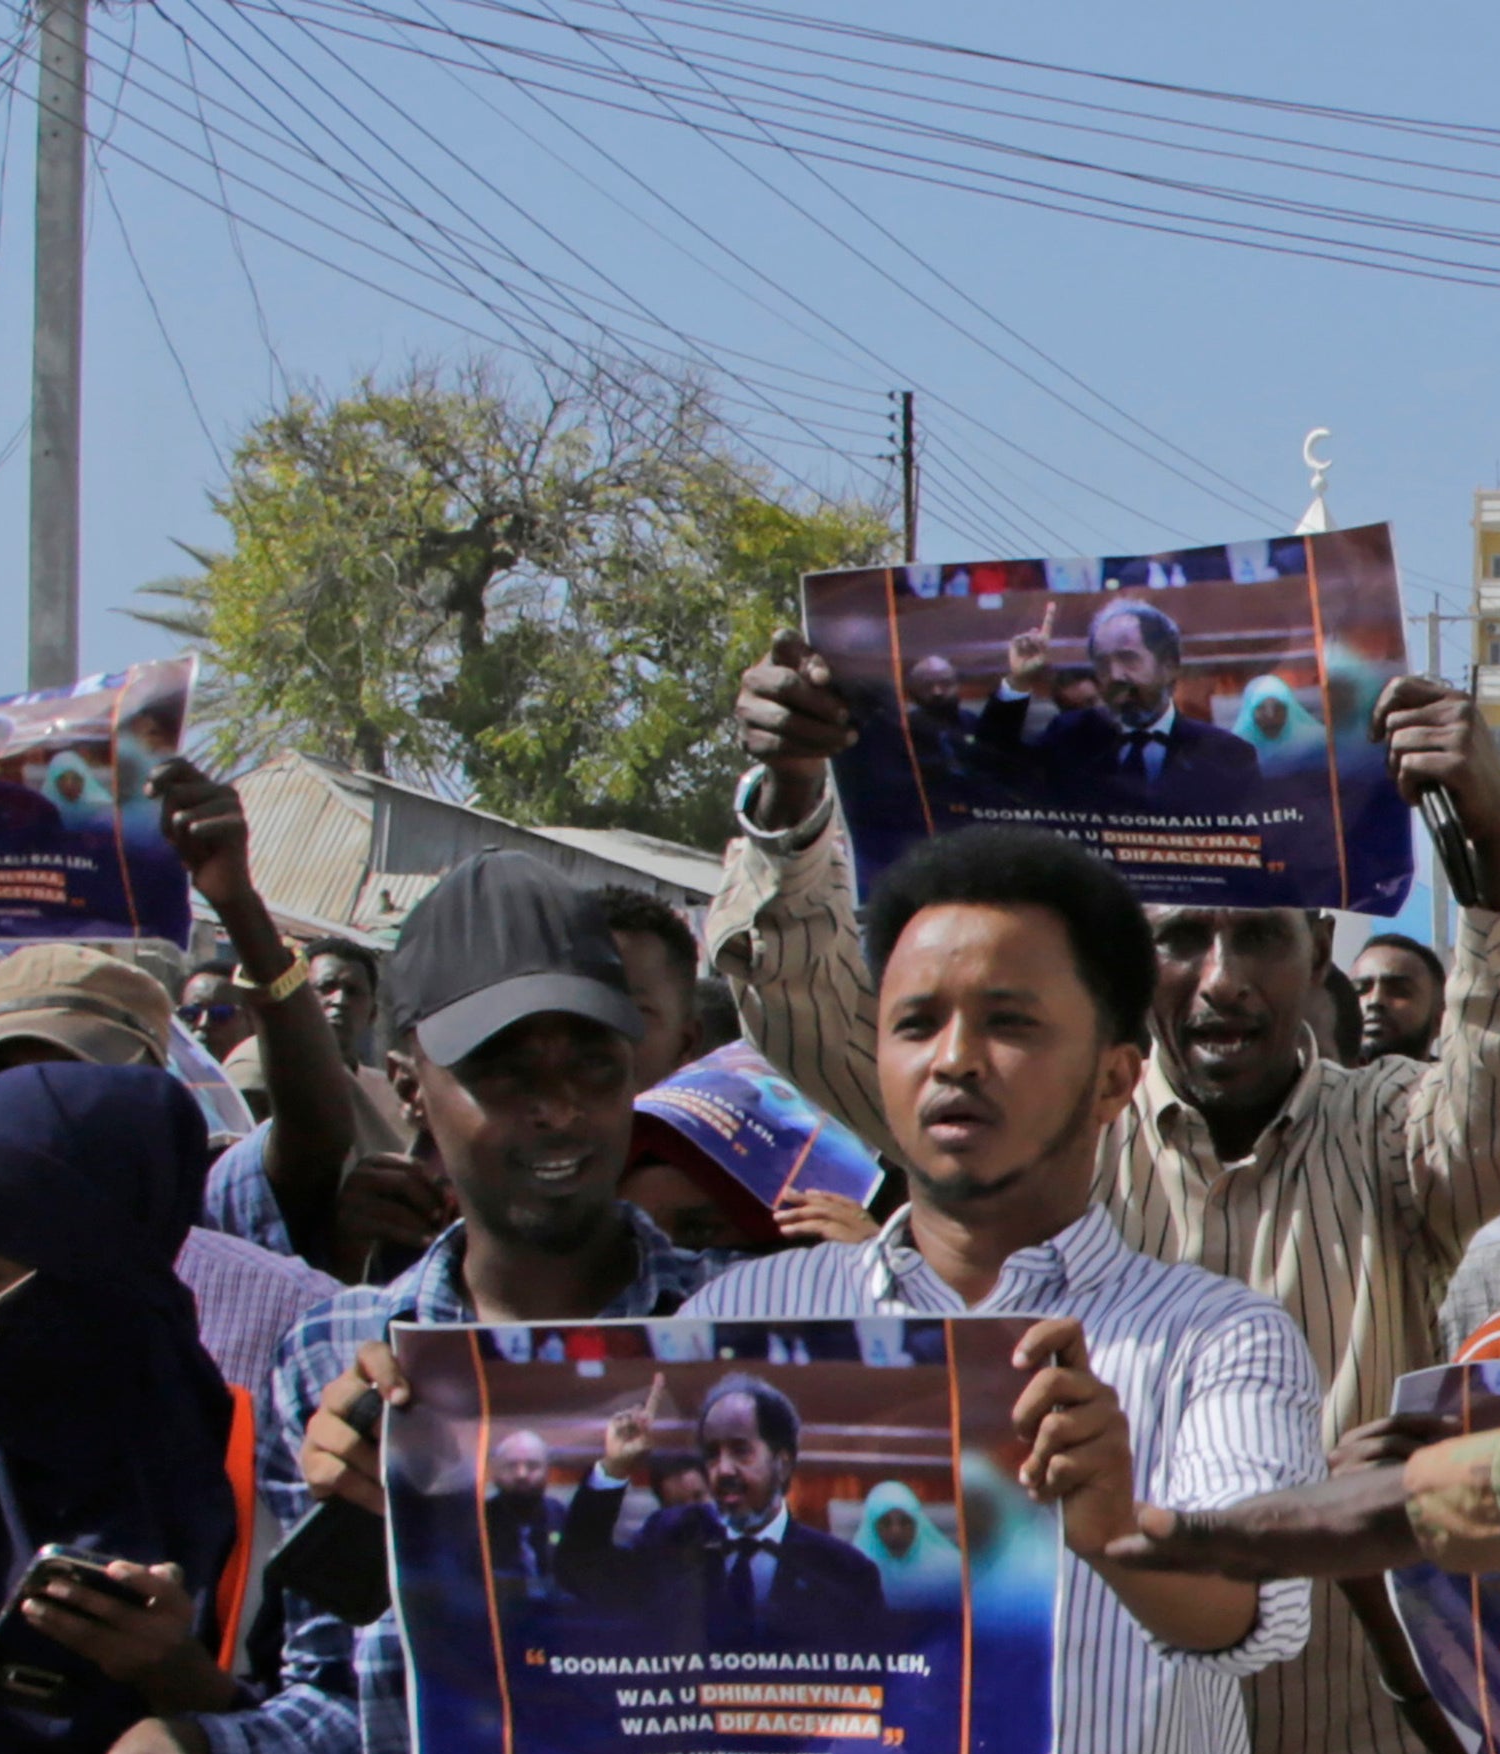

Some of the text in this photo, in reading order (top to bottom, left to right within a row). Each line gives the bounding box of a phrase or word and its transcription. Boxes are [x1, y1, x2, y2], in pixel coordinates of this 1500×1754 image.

[972, 807, 1305, 828] SOOMAALIYA SOOMAALI BAA LEH,
[550, 1652, 931, 1677] SOOMAALIYA SOOMAALI BAA LEH,
[616, 1685, 882, 1708] WAA U DHIMANEYNAA,
[621, 1711, 880, 1735] WAANA DIFAACEYNAA
